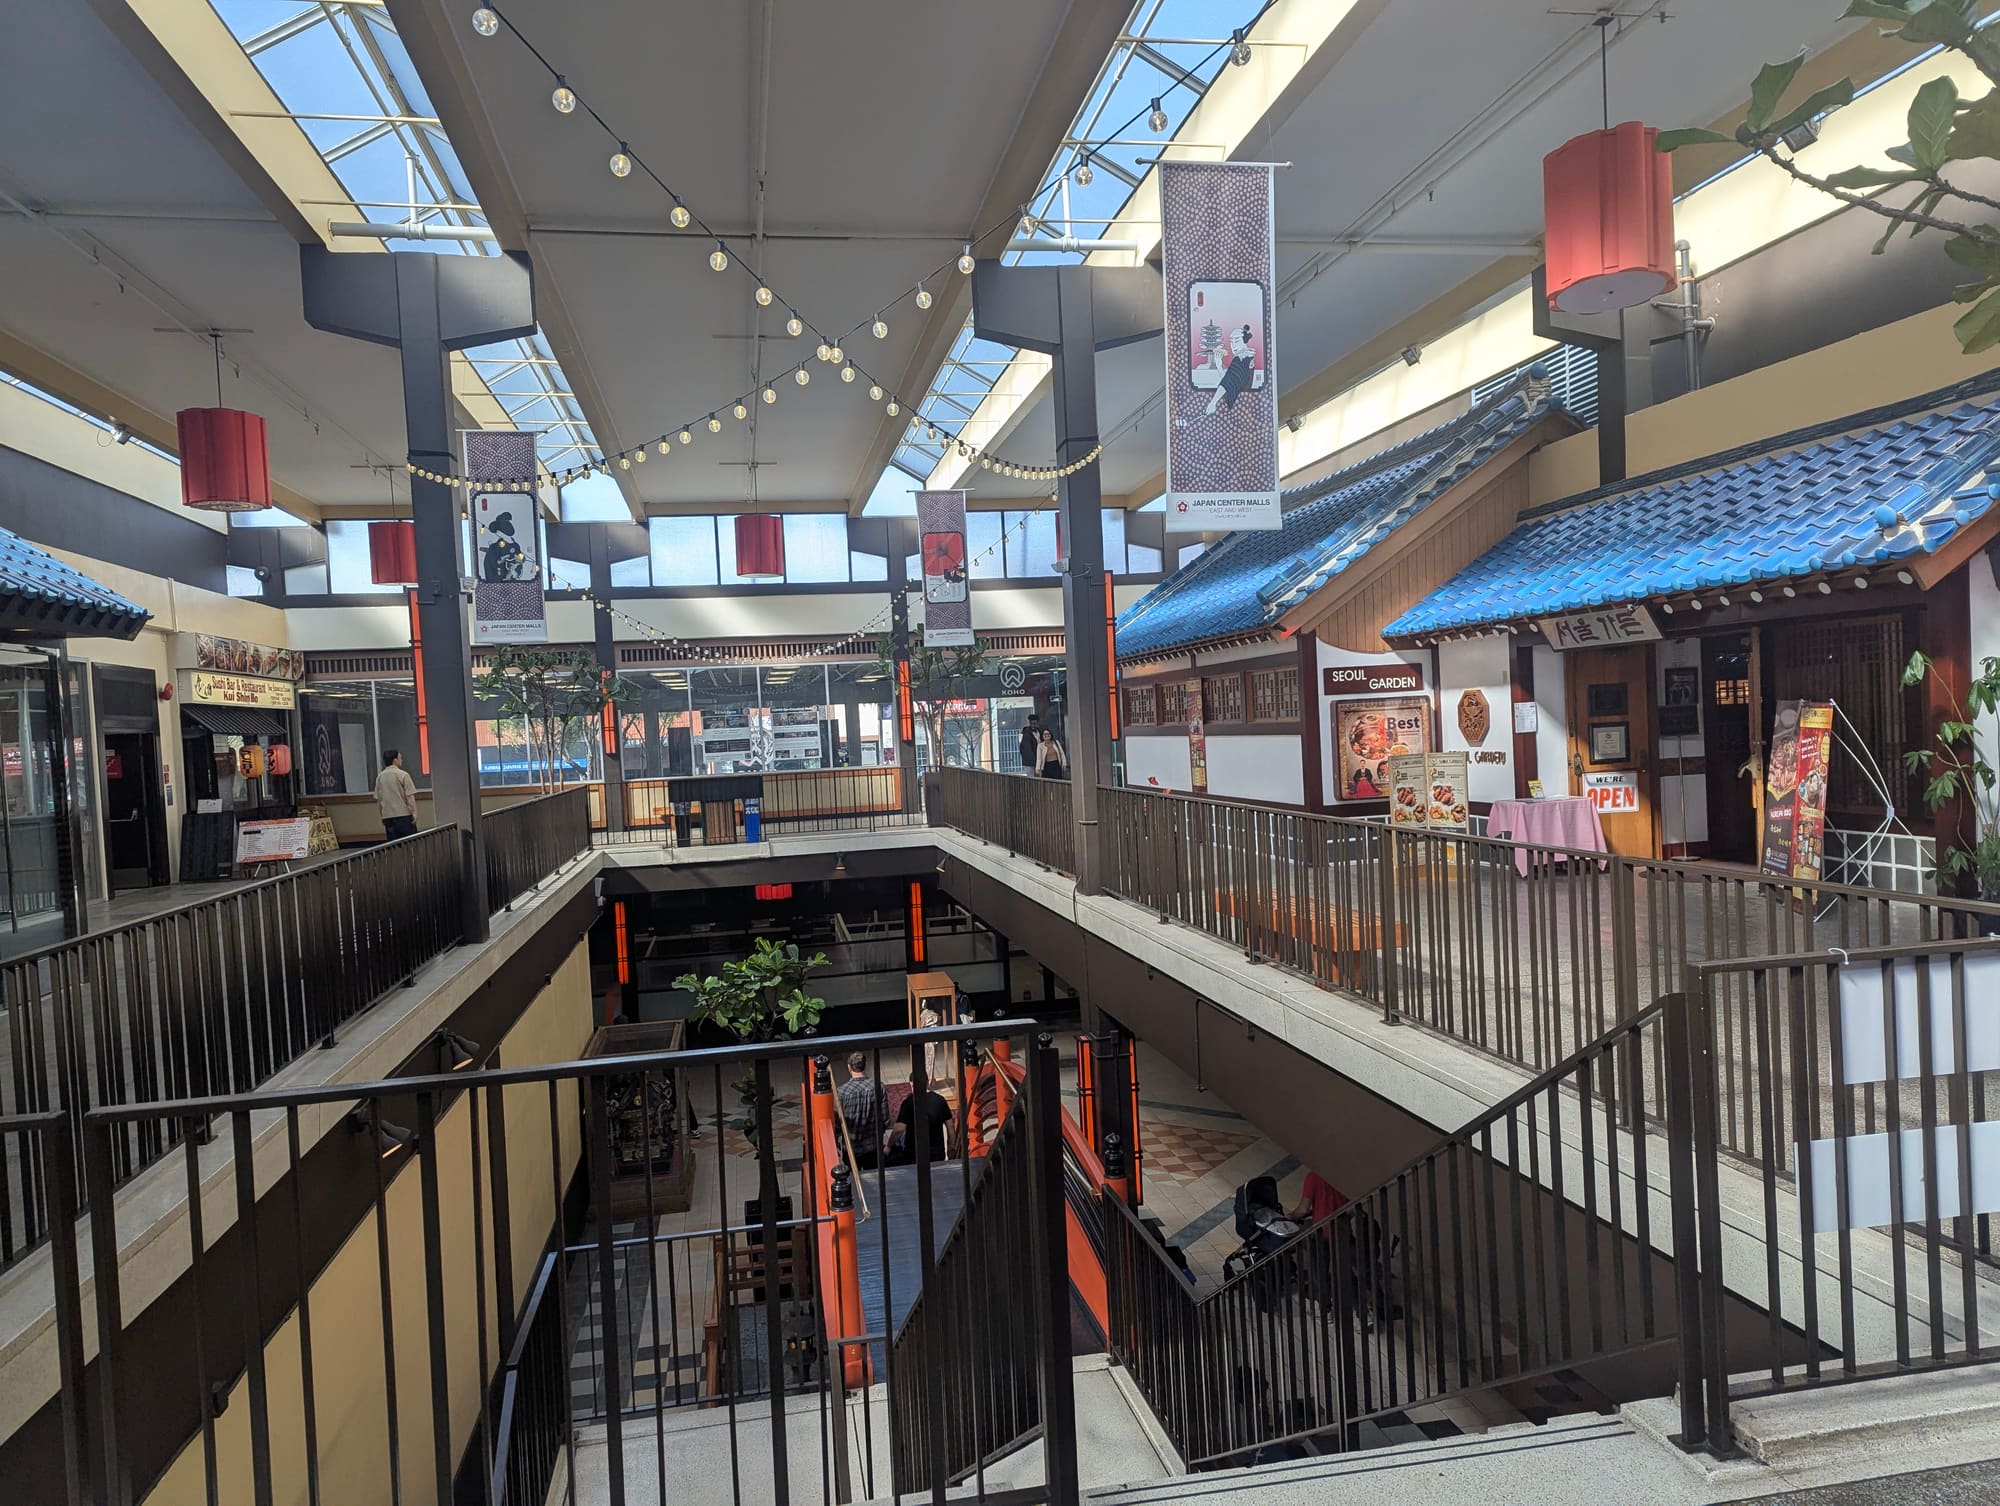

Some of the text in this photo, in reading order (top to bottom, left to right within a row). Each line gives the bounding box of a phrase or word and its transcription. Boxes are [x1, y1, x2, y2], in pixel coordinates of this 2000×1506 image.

[1246, 498, 1271, 506] MALLS
[1332, 670, 1367, 682] SEOUL
[211, 675, 226, 690] Sushi
[227, 678, 235, 691] Bar
[241, 680, 266, 694] Restaurant
[1369, 677, 1416, 689] GARDEN
[223, 691, 235, 701] Kui
[1386, 716, 1421, 729] Best
[1595, 775, 1624, 783] WE'RE
[1587, 786, 1635, 808] OPEN
